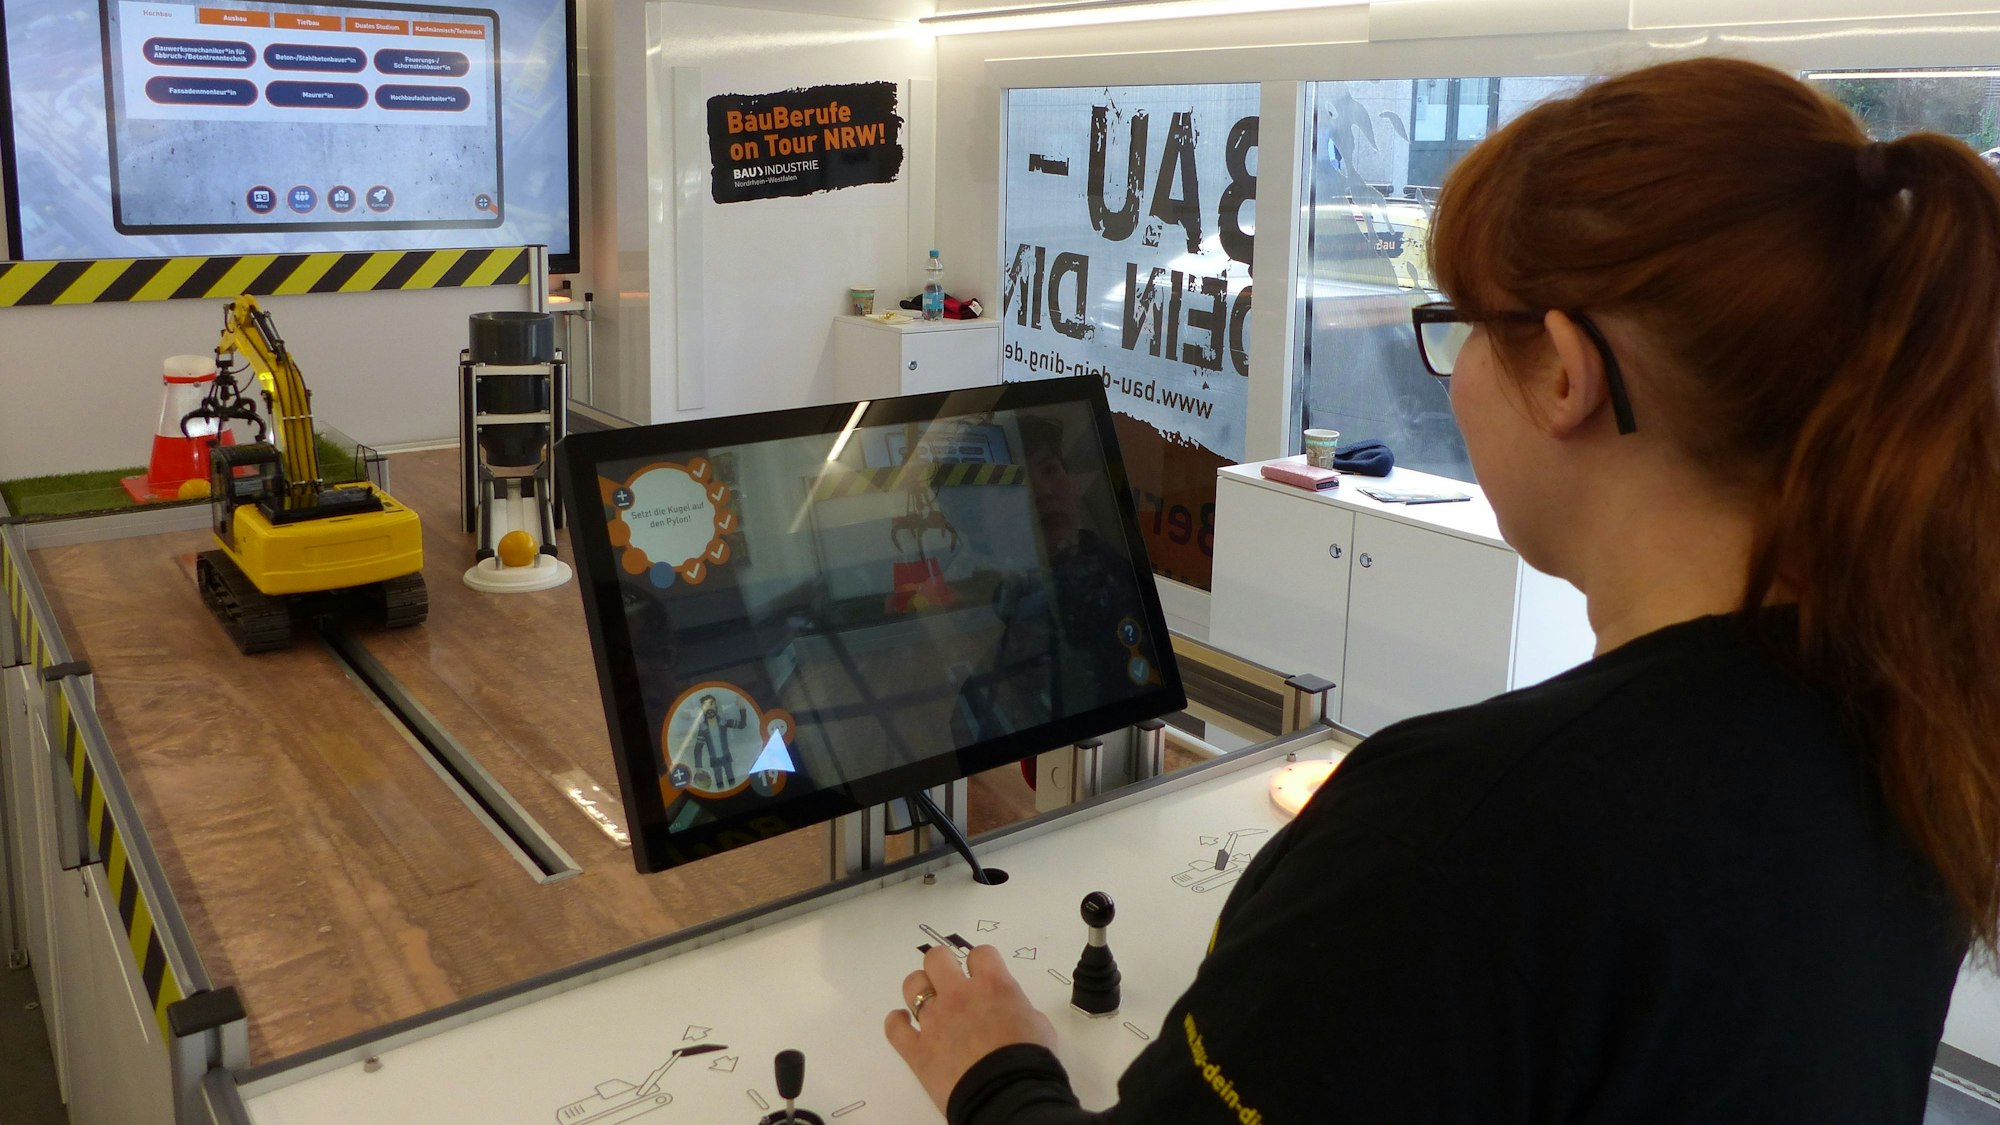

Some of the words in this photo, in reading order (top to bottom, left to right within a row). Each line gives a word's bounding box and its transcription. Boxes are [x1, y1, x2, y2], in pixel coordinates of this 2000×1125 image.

[143, 9, 172, 17] Hochbau
[296, 18, 320, 27] Tiefbau
[354, 22, 375, 30] Duales
[376, 23, 400, 31] Studium
[415, 25, 483, 36] Kaufmännisch/Technisch
[154, 52, 247, 62] Abbruch-/Betontrenntechnik
[726, 101, 852, 134] BauBerufe
[730, 141, 759, 161] on
[764, 132, 818, 157] Tour
[823, 123, 886, 151] NRW!
[734, 174, 798, 188] Nordrhein-Westfalen
[631, 510, 652, 519] Setzt
[654, 508, 666, 516] die
[667, 503, 691, 514] Kugel
[650, 519, 665, 528] den
[666, 515, 691, 526] Pylon!
